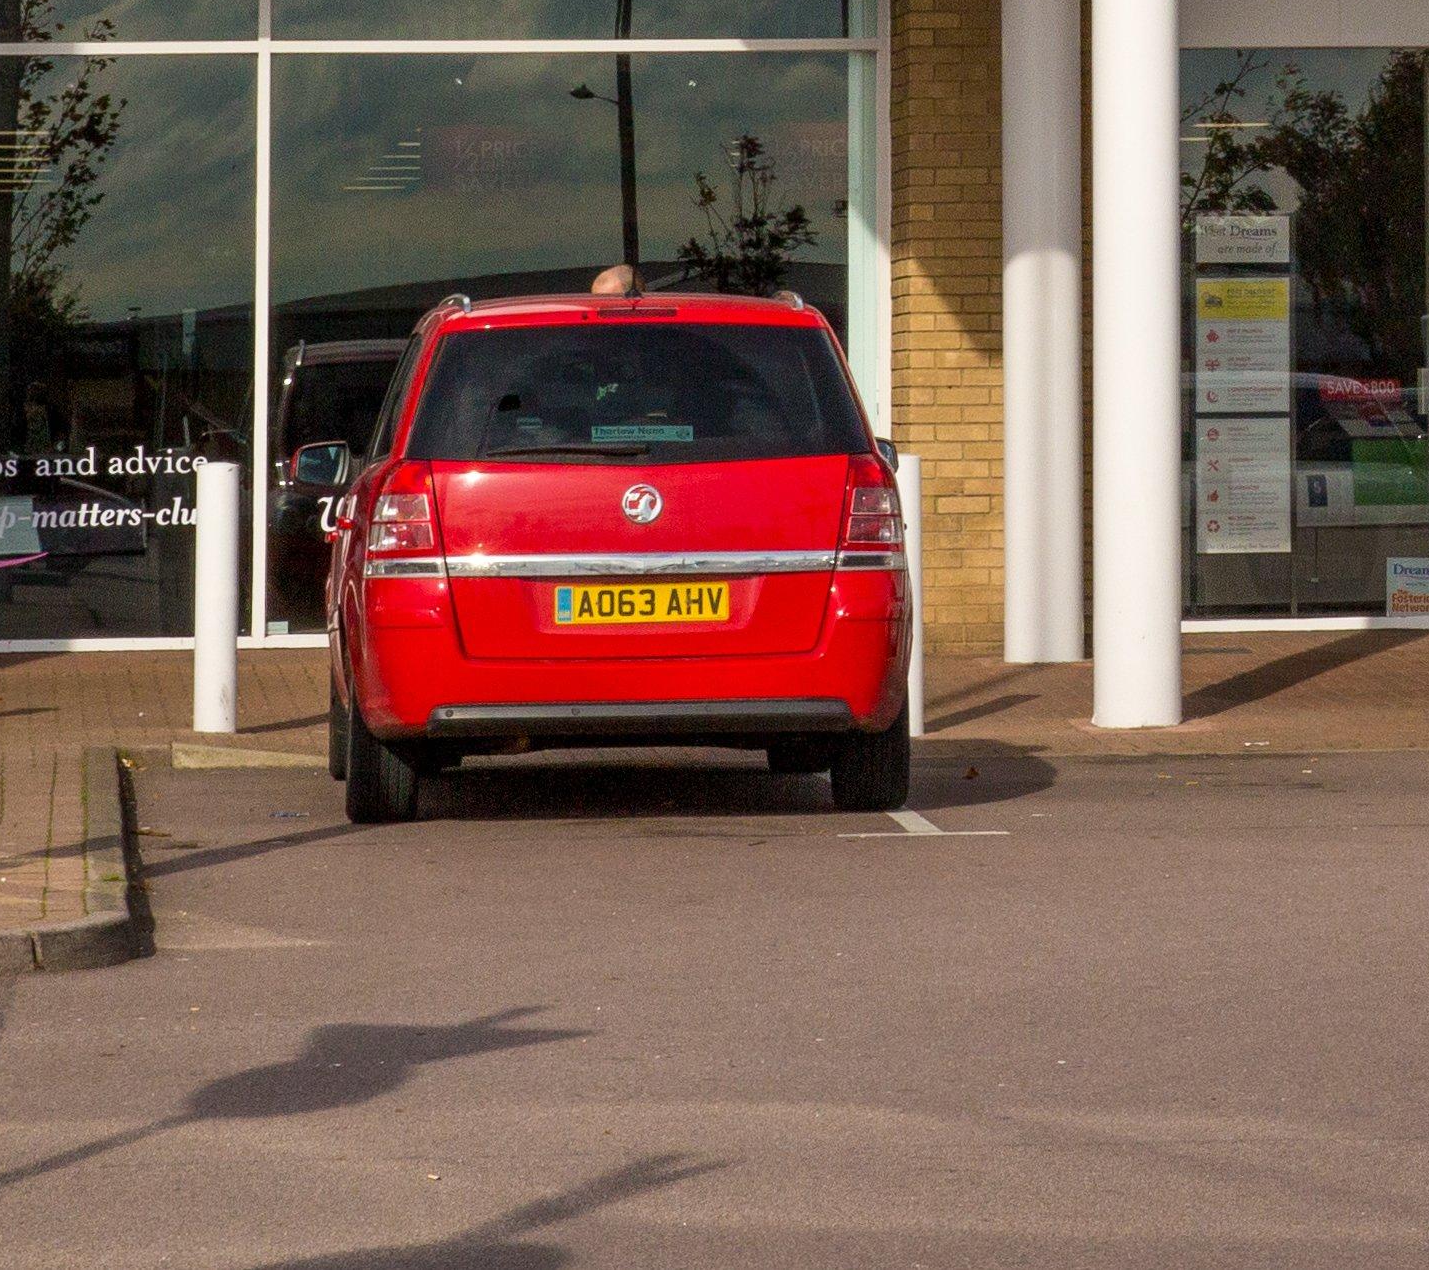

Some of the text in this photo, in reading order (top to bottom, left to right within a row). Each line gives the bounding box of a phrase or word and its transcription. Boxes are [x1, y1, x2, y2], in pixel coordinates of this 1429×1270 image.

[1229, 224, 1278, 237] Dreams
[35, 445, 98, 476] and
[107, 445, 208, 475] advice
[666, 587, 723, 617] AHV
